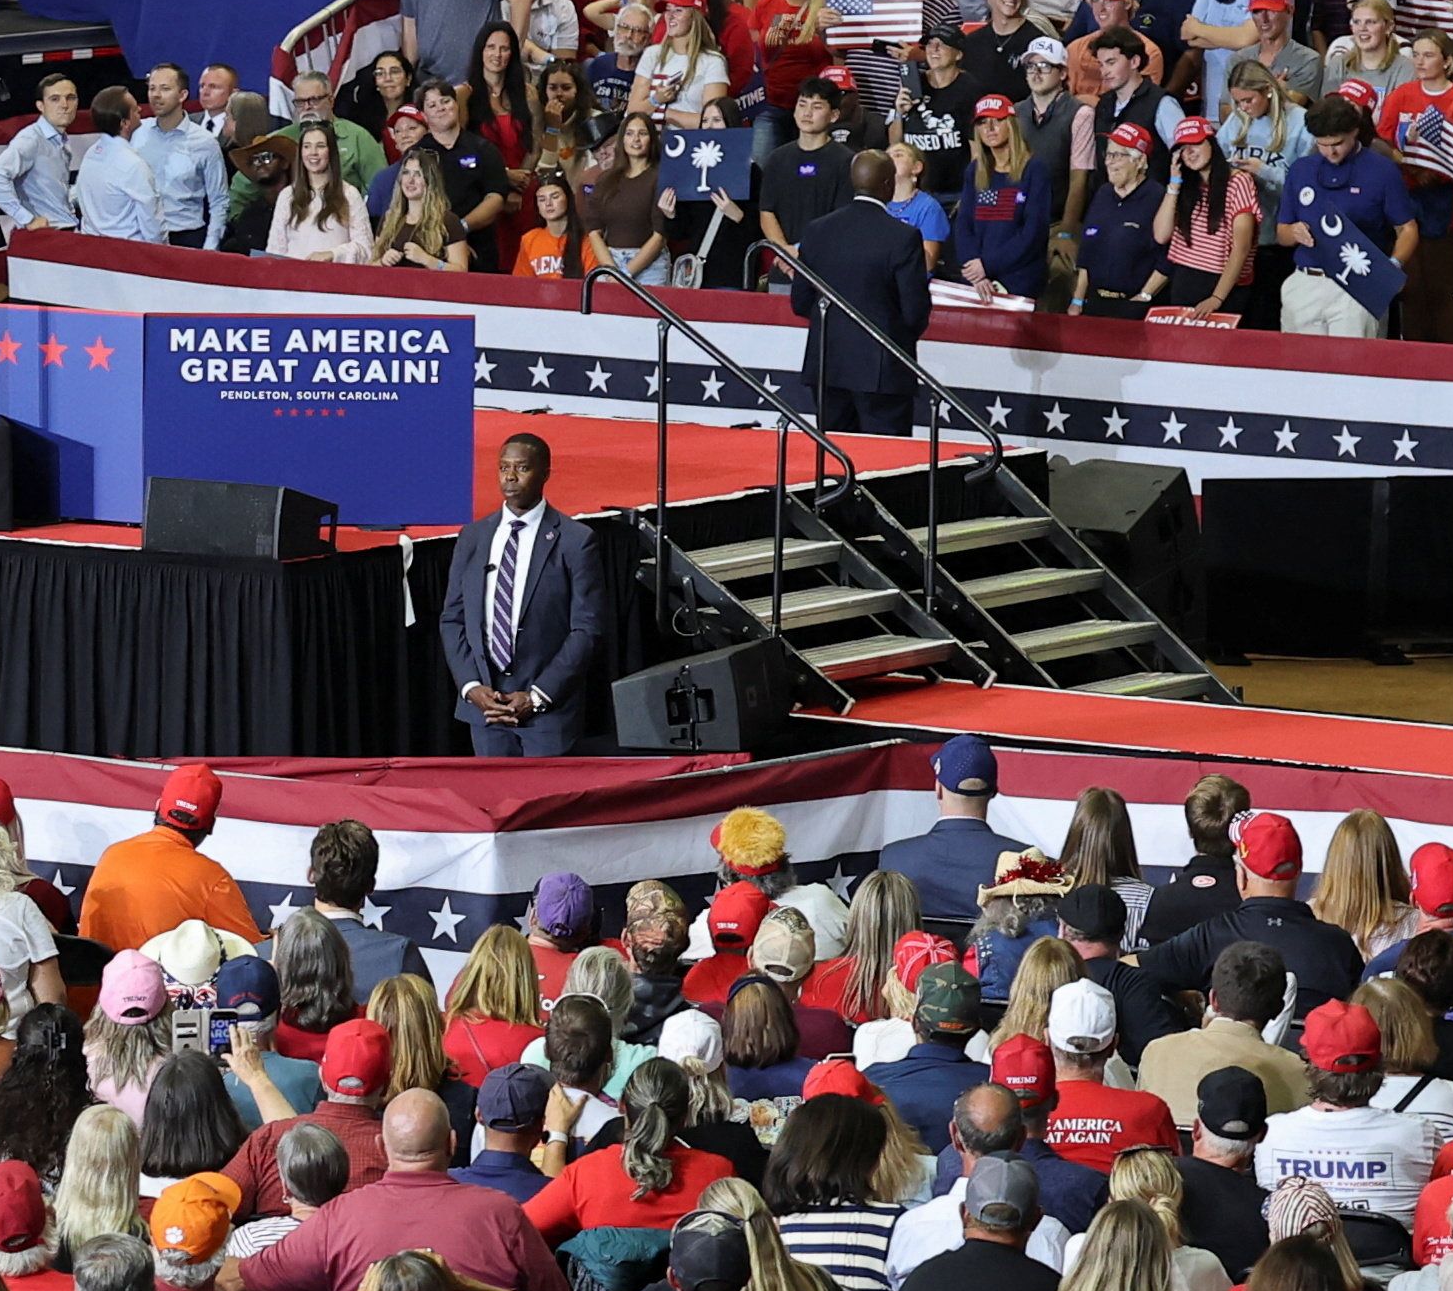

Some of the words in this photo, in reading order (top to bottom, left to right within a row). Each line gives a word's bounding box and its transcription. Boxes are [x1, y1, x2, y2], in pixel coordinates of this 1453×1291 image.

[976, 98, 1002, 114] TRUMP
[945, 132, 963, 150] ME
[170, 328, 271, 353] MAKE
[290, 328, 450, 354] AMERICA
[180, 358, 299, 383] GREAT
[312, 359, 440, 384] AGAIN!
[221, 390, 292, 402] PENDLETON,
[295, 390, 335, 402] SOUTH
[338, 390, 399, 402] CAROLINA
[716, 921, 739, 929] TRUMP
[122, 993, 148, 1003] TRUMP
[1006, 1075, 1037, 1085] TRUMP
[1052, 1118, 1122, 1133] AMERICA
[1067, 1131, 1112, 1145] AGAIN
[1276, 1157, 1387, 1179] TRUMP
